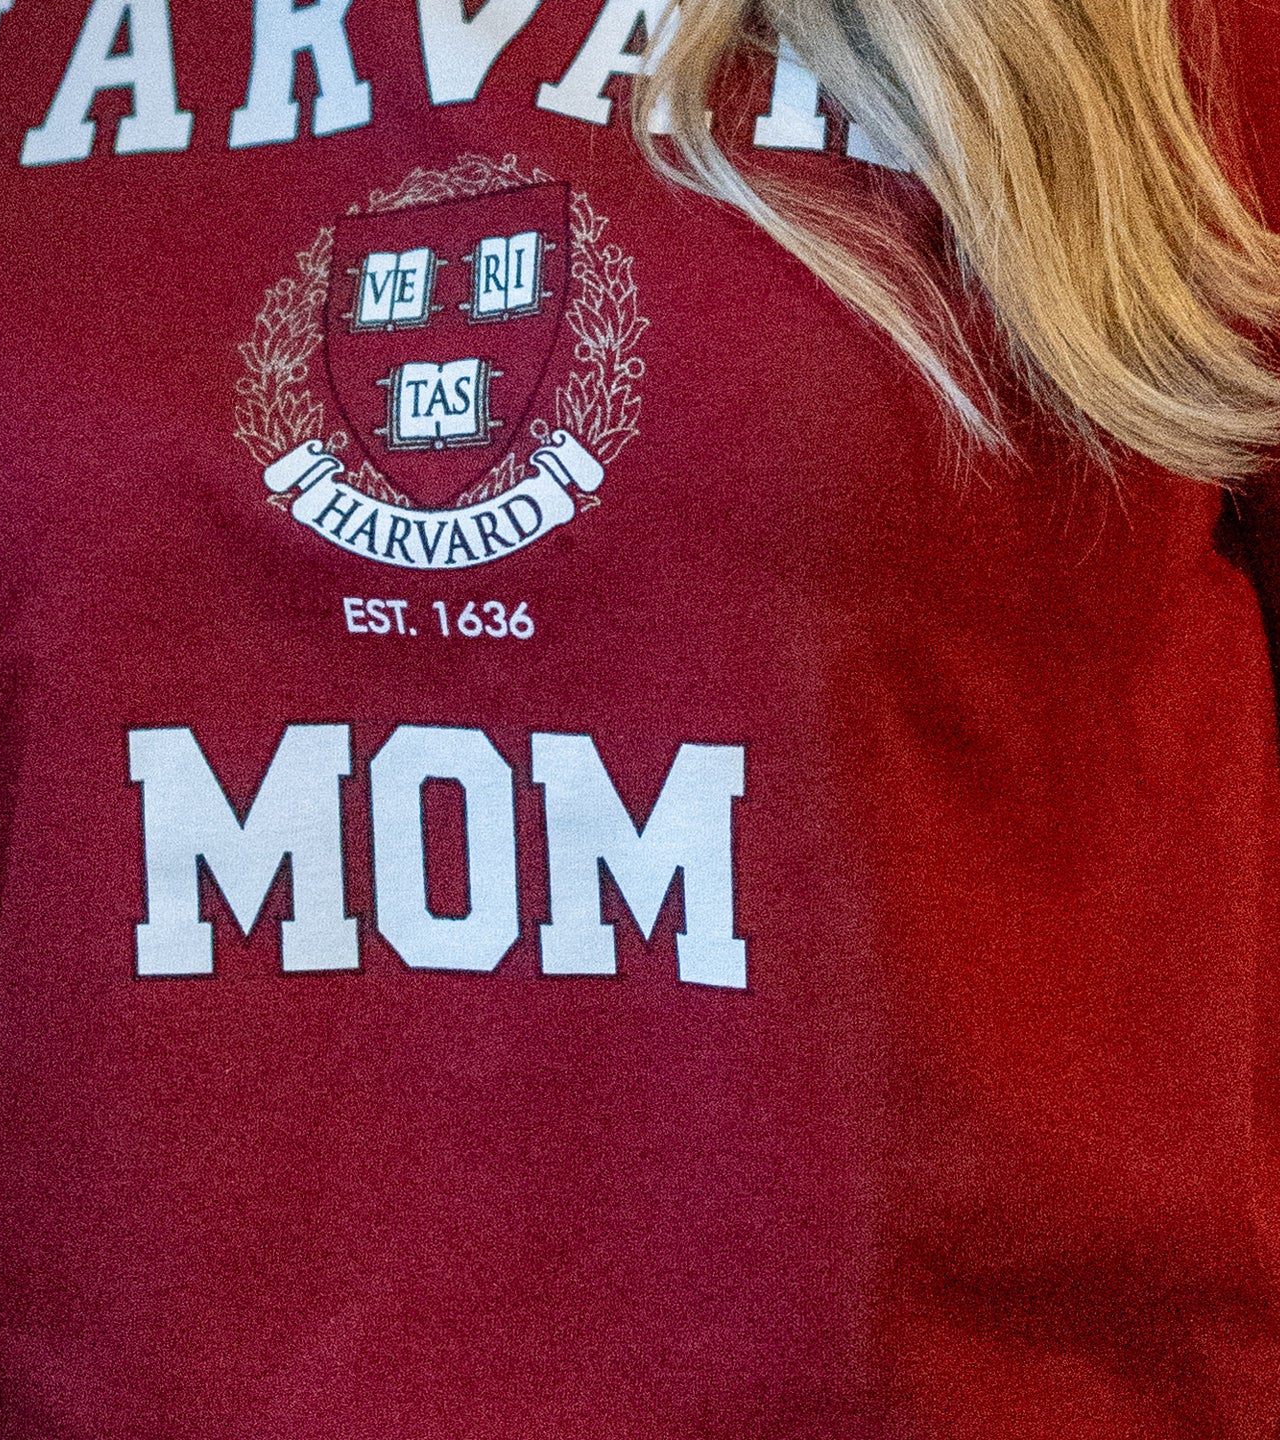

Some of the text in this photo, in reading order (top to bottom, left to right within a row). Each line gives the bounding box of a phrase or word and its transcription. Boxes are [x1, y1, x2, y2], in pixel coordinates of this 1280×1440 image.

[368, 247, 526, 305] VE RI
[405, 375, 471, 419] TAS
[313, 488, 544, 566] HARVARD
[343, 597, 536, 640] EST. 1636
[126, 721, 750, 992] MOM
